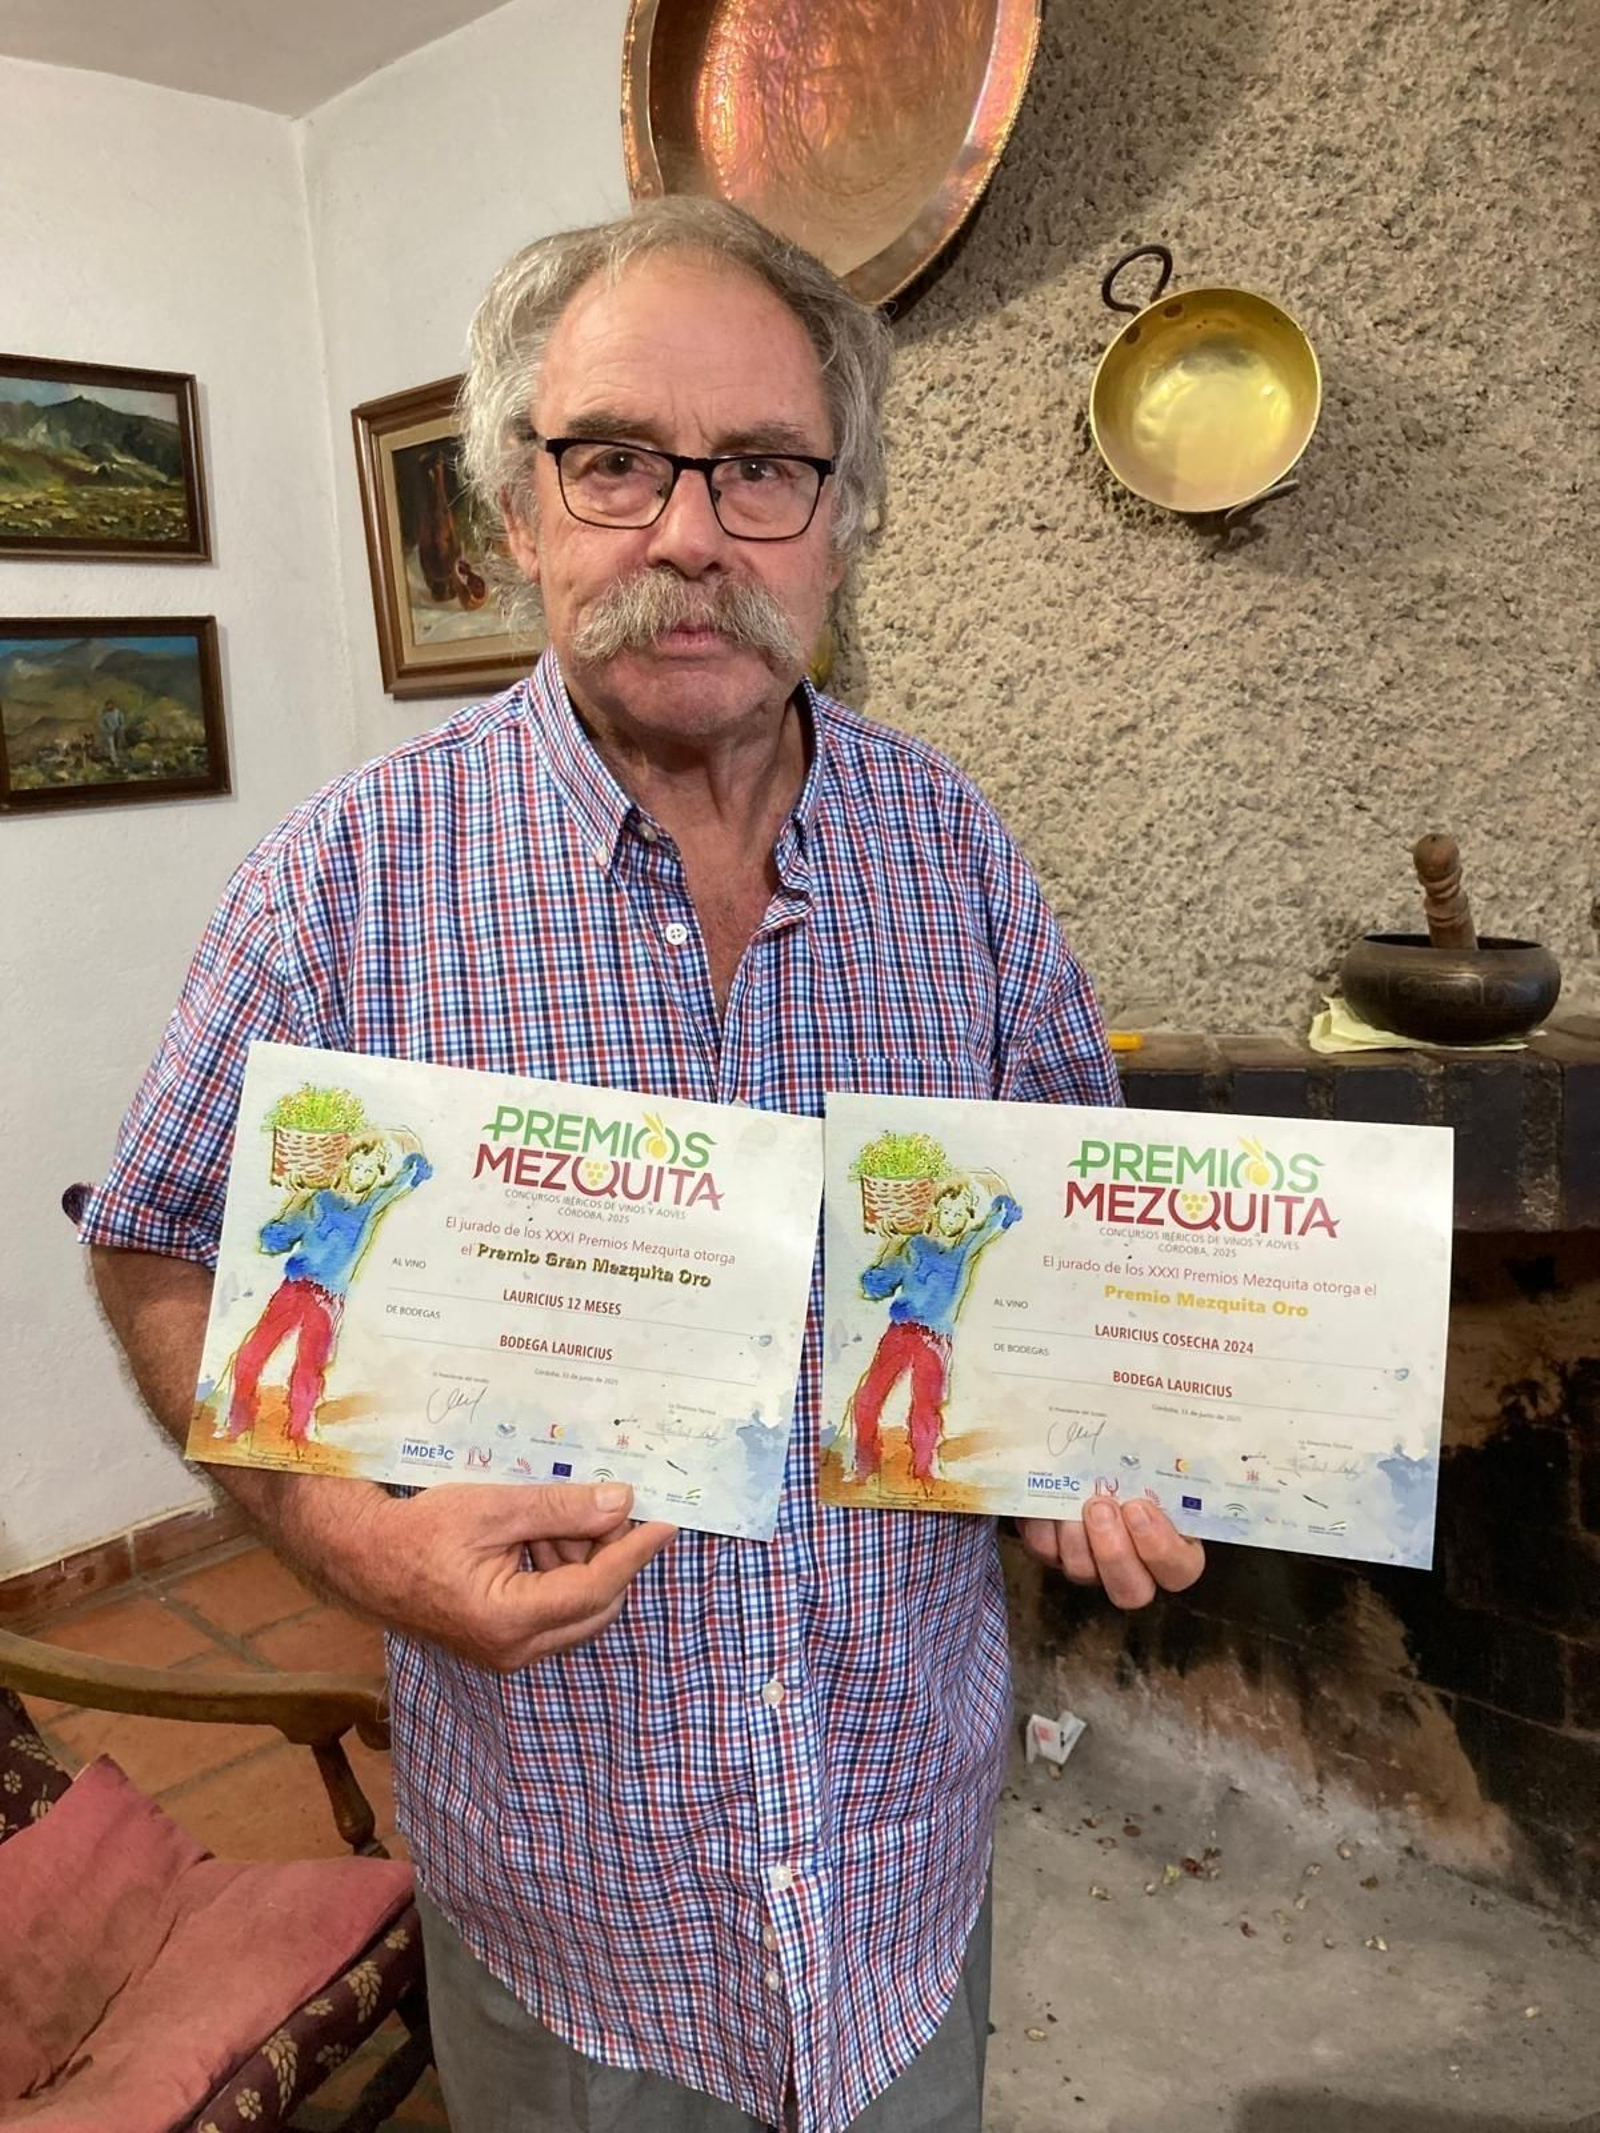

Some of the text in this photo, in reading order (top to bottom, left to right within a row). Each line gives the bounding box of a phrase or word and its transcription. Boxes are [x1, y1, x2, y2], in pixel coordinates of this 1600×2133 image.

[482, 1105, 719, 1169] PREMIOS
[471, 1143, 726, 1211] MEZQUITA
[1067, 1140, 1326, 1194] PREMIOS
[505, 1188, 561, 1204] CONCURSOS
[604, 1201, 616, 1211] DE
[619, 1203, 646, 1214] VINOS
[1064, 1181, 1341, 1238] MEZQUITA
[607, 1212, 630, 1224] 2025
[445, 1216, 736, 1266] El jurado de los XXXI Premios Mezquita otorga
[1100, 1227, 1159, 1240] CONCURSOS
[1208, 1234, 1219, 1244] DE
[1223, 1236, 1253, 1247] VINOS
[1256, 1237, 1263, 1247] Y
[392, 1257, 427, 1269] AL VINO
[460, 1243, 712, 1288] el Premio Gran Mezquita Oro
[1213, 1246, 1237, 1258] 2025
[1043, 1255, 1377, 1298] El jurado de los XXXI Premios Mezquita otorga el
[386, 1304, 441, 1320] DE BODEGAS
[503, 1288, 622, 1315] LAURICIUS 12 MESES
[994, 1298, 1029, 1309] AL VINO
[1104, 1284, 1309, 1318] Premio Mezquita Oro
[500, 1335, 613, 1361] BODEGA LAURICIUS
[993, 1343, 1050, 1357] DE BODEGAS
[1095, 1324, 1255, 1355] LAURICIUS COSECHA 2024
[1113, 1370, 1233, 1398] BODEGA LAURICIUS
